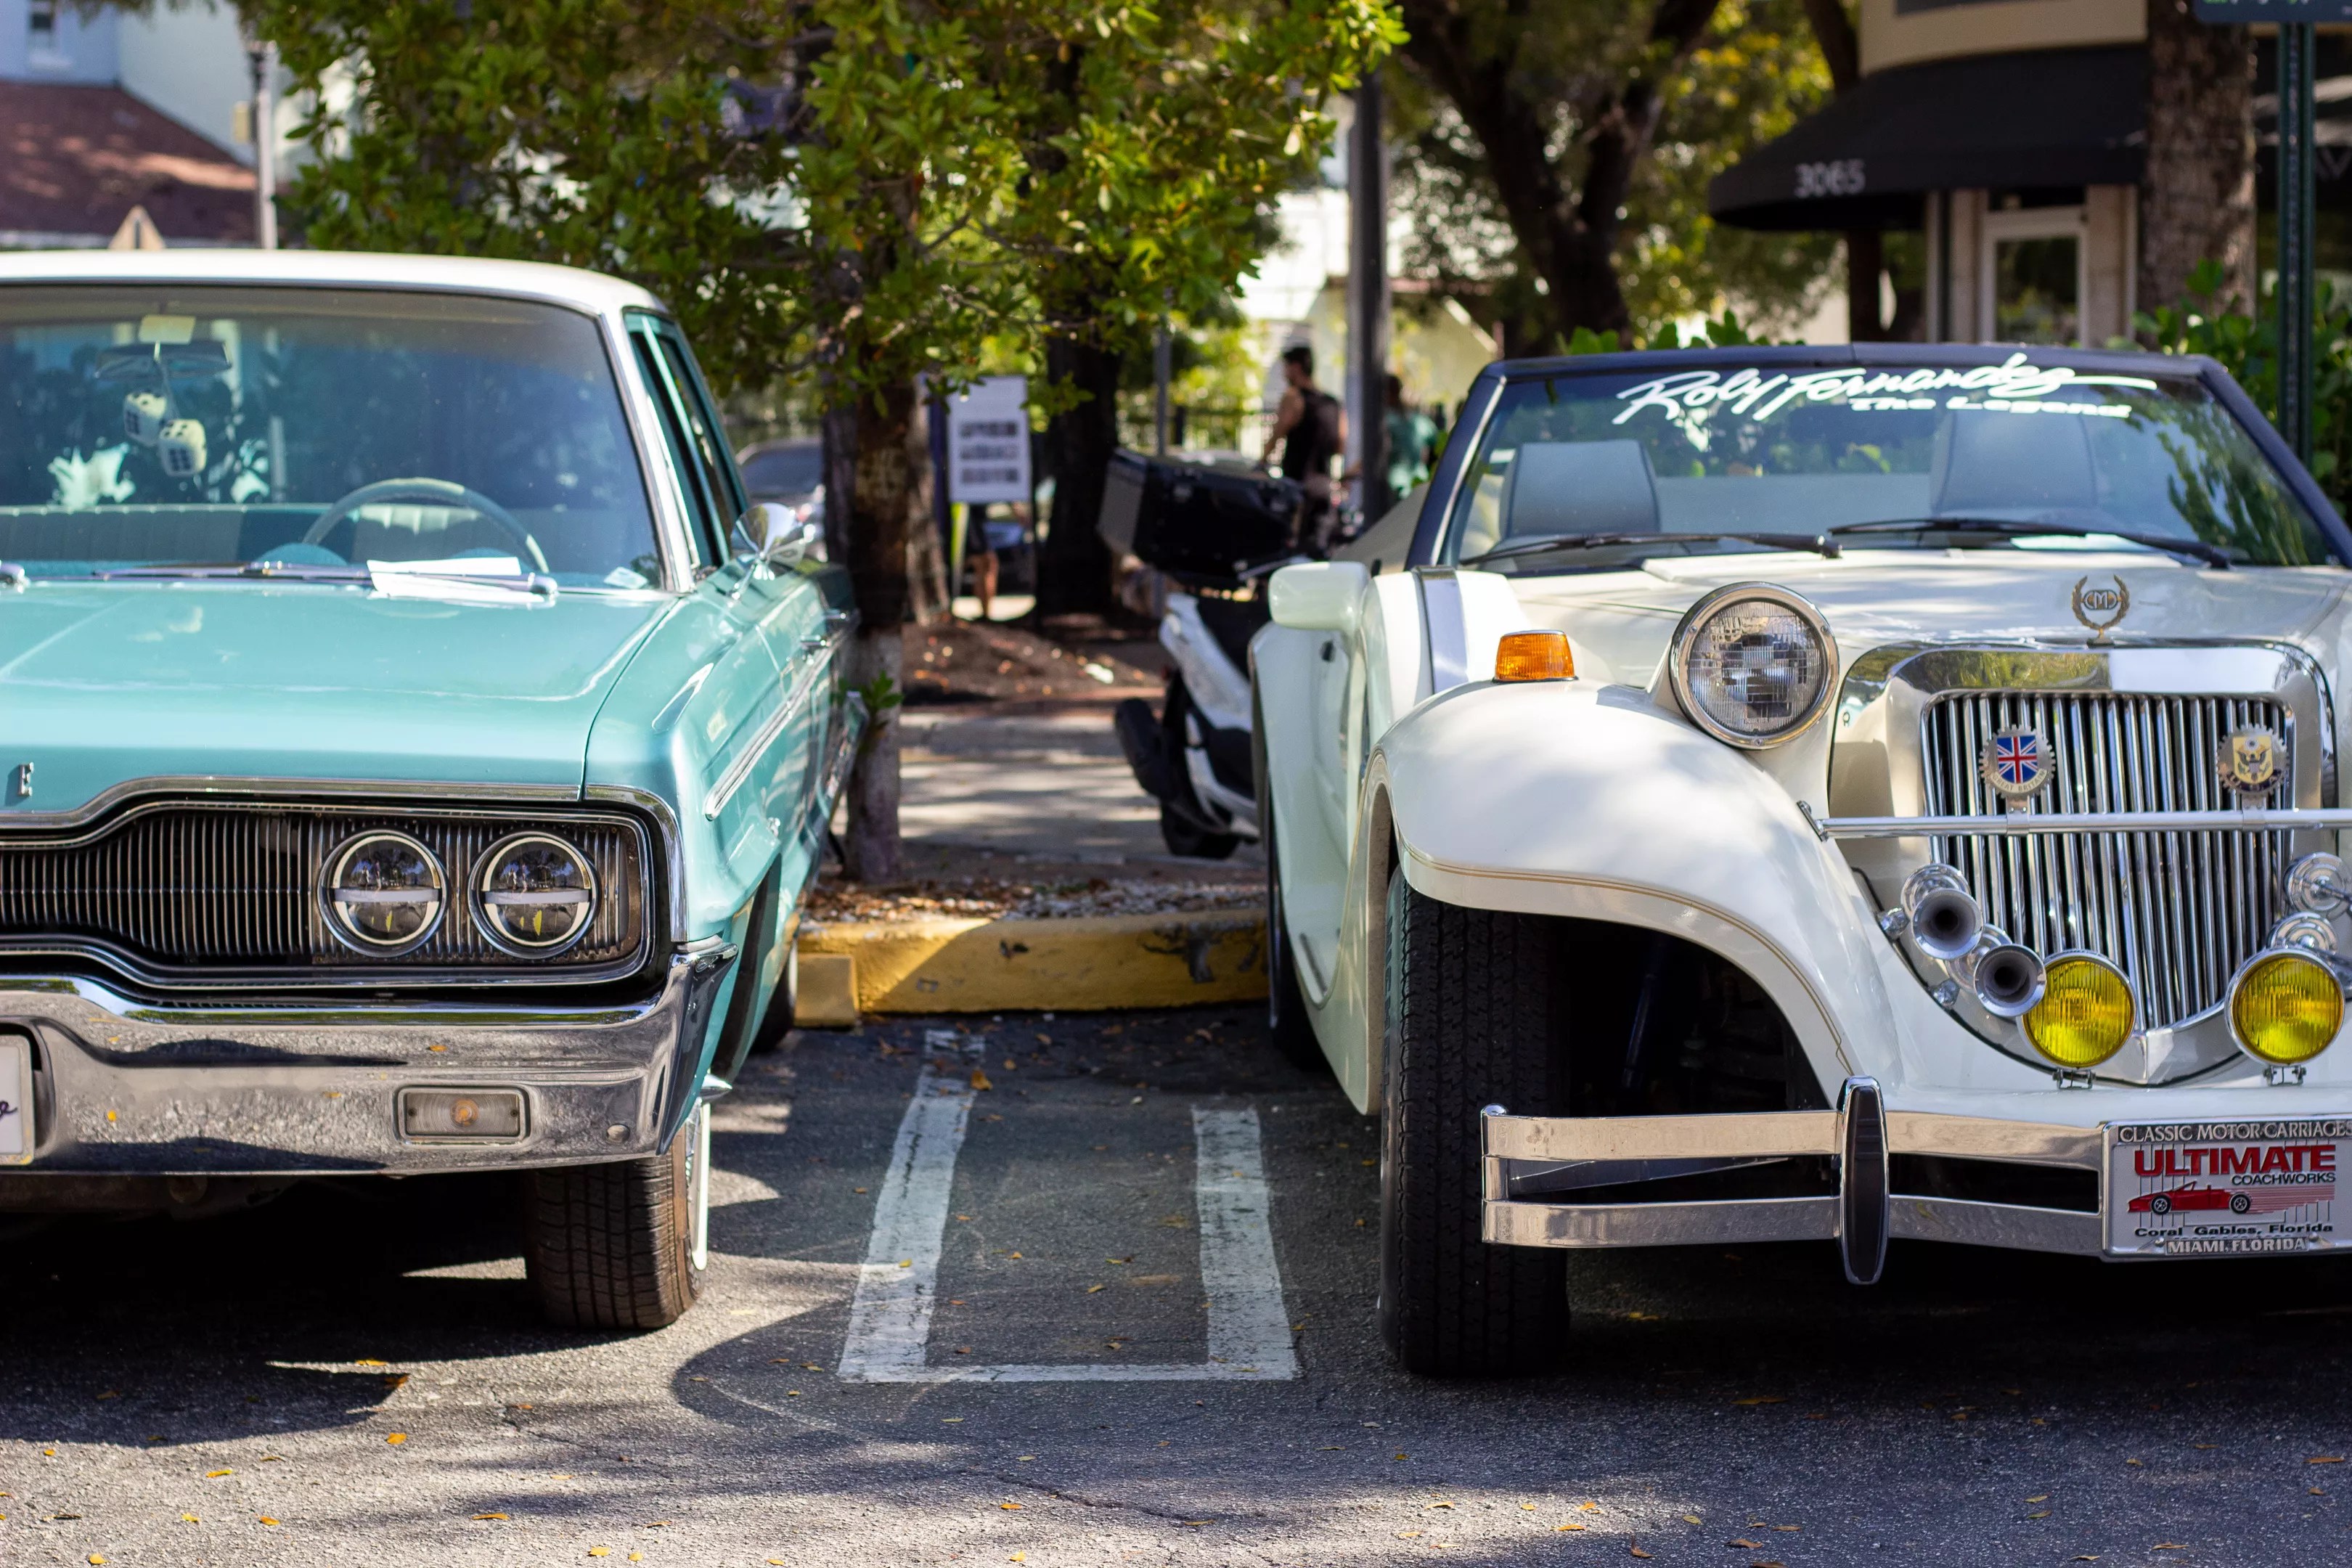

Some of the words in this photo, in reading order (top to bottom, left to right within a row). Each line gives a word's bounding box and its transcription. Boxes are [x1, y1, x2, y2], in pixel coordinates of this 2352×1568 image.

[1794, 159, 1866, 197] 3065
[1752, 352, 2157, 421] Fernandez
[2120, 1125, 2193, 1143] CLASSIC
[2197, 1122, 2261, 1140] MOTOR
[2134, 1145, 2336, 1176] ULTIMATE
[2231, 1172, 2336, 1185] COACHWORKS
[2135, 1228, 2183, 1236] Coral
[2194, 1225, 2262, 1236] Gables,
[2269, 1223, 2333, 1233] Florida
[2167, 1240, 2229, 1253] MIAMI,
[2232, 1238, 2306, 1251] FLORIDA
